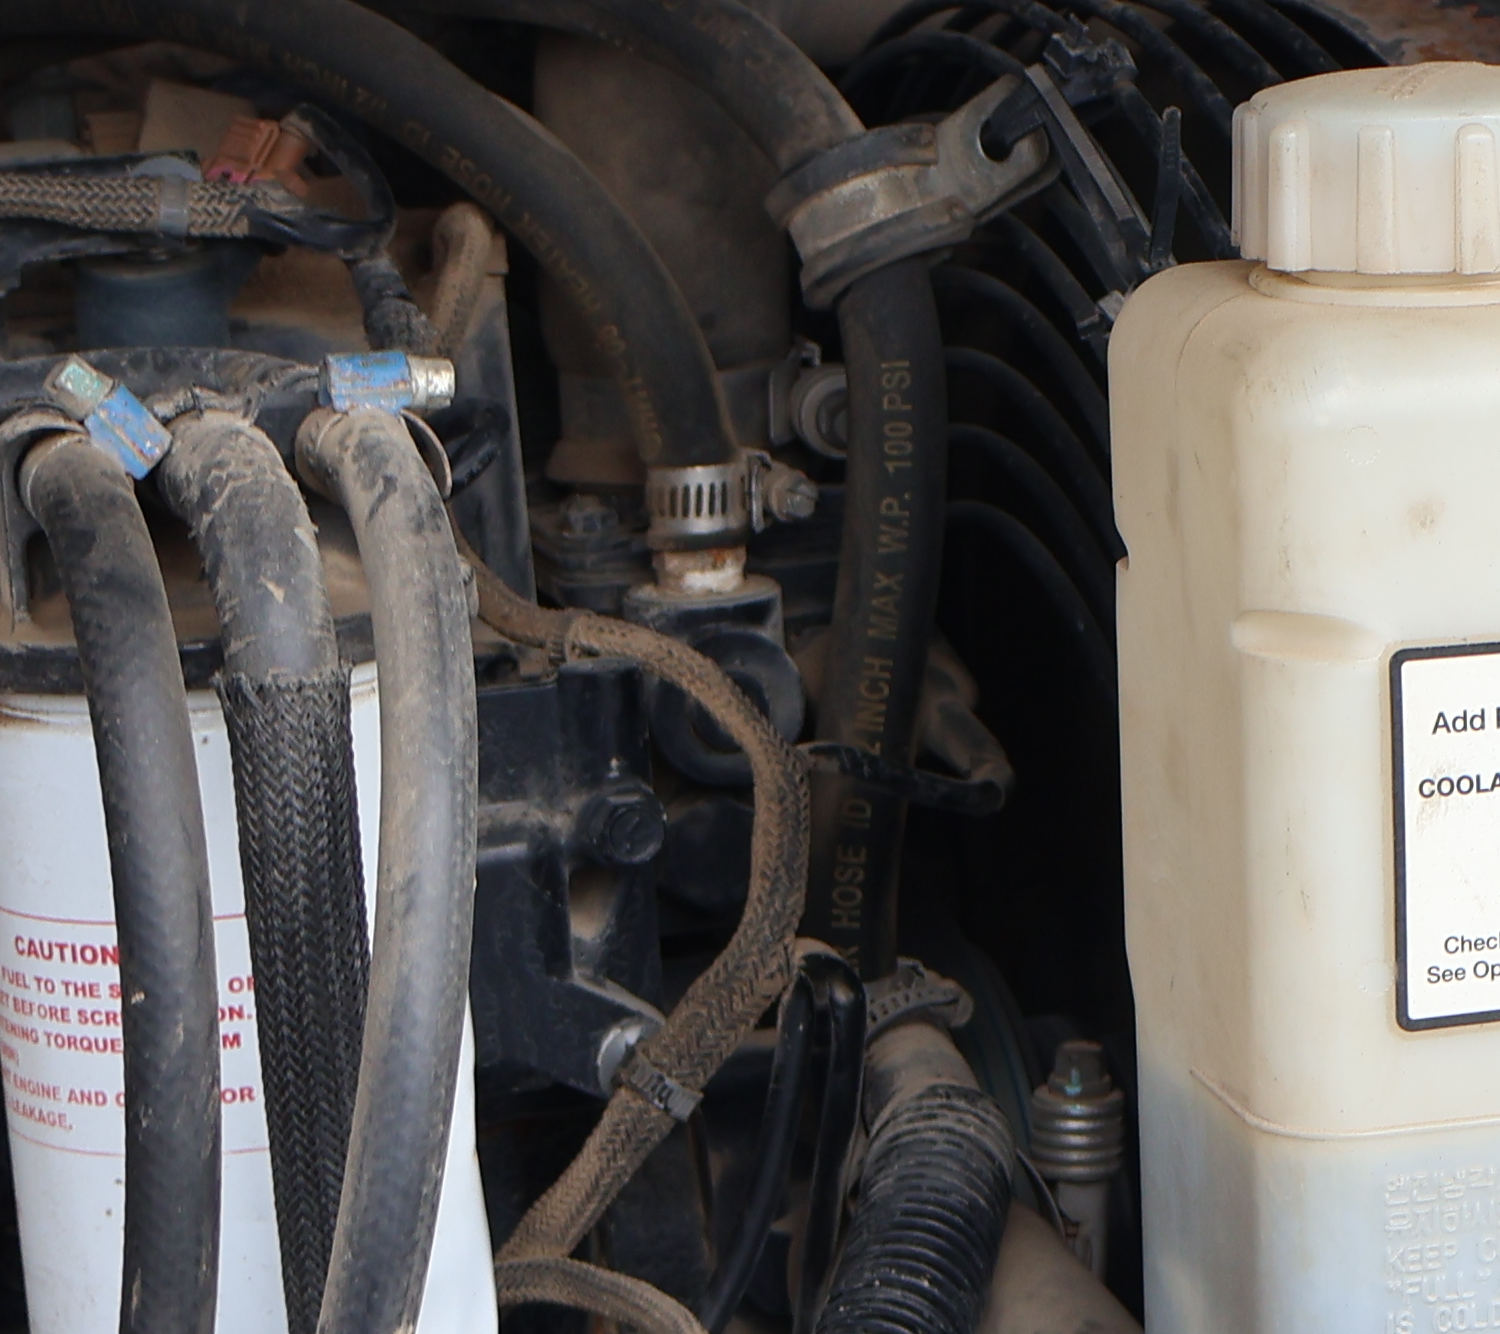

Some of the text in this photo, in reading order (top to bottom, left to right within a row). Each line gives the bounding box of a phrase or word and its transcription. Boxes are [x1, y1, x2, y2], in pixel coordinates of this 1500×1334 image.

[444, 148, 512, 213] HOSE
[880, 359, 913, 421] PSI
[882, 426, 914, 477] 100
[877, 493, 912, 559] W.P.
[869, 573, 904, 641] MAX
[857, 655, 896, 729] INCH
[1433, 709, 1485, 734] Add
[846, 801, 871, 828] ID
[832, 844, 867, 929] HOSE
[14, 935, 119, 966] CAUTION
[2, 967, 29, 989] FUEL
[34, 976, 55, 994] TO
[61, 981, 101, 999] THE
[1428, 967, 1465, 983] See
[13, 998, 71, 1023] BEFORE
[44, 1031, 122, 1054] TORQUE
[13, 1075, 61, 1101] ENGINE
[68, 1087, 107, 1107] AND
[220, 1085, 256, 1104] OR
[1386, 1242, 1459, 1273] KEEP
